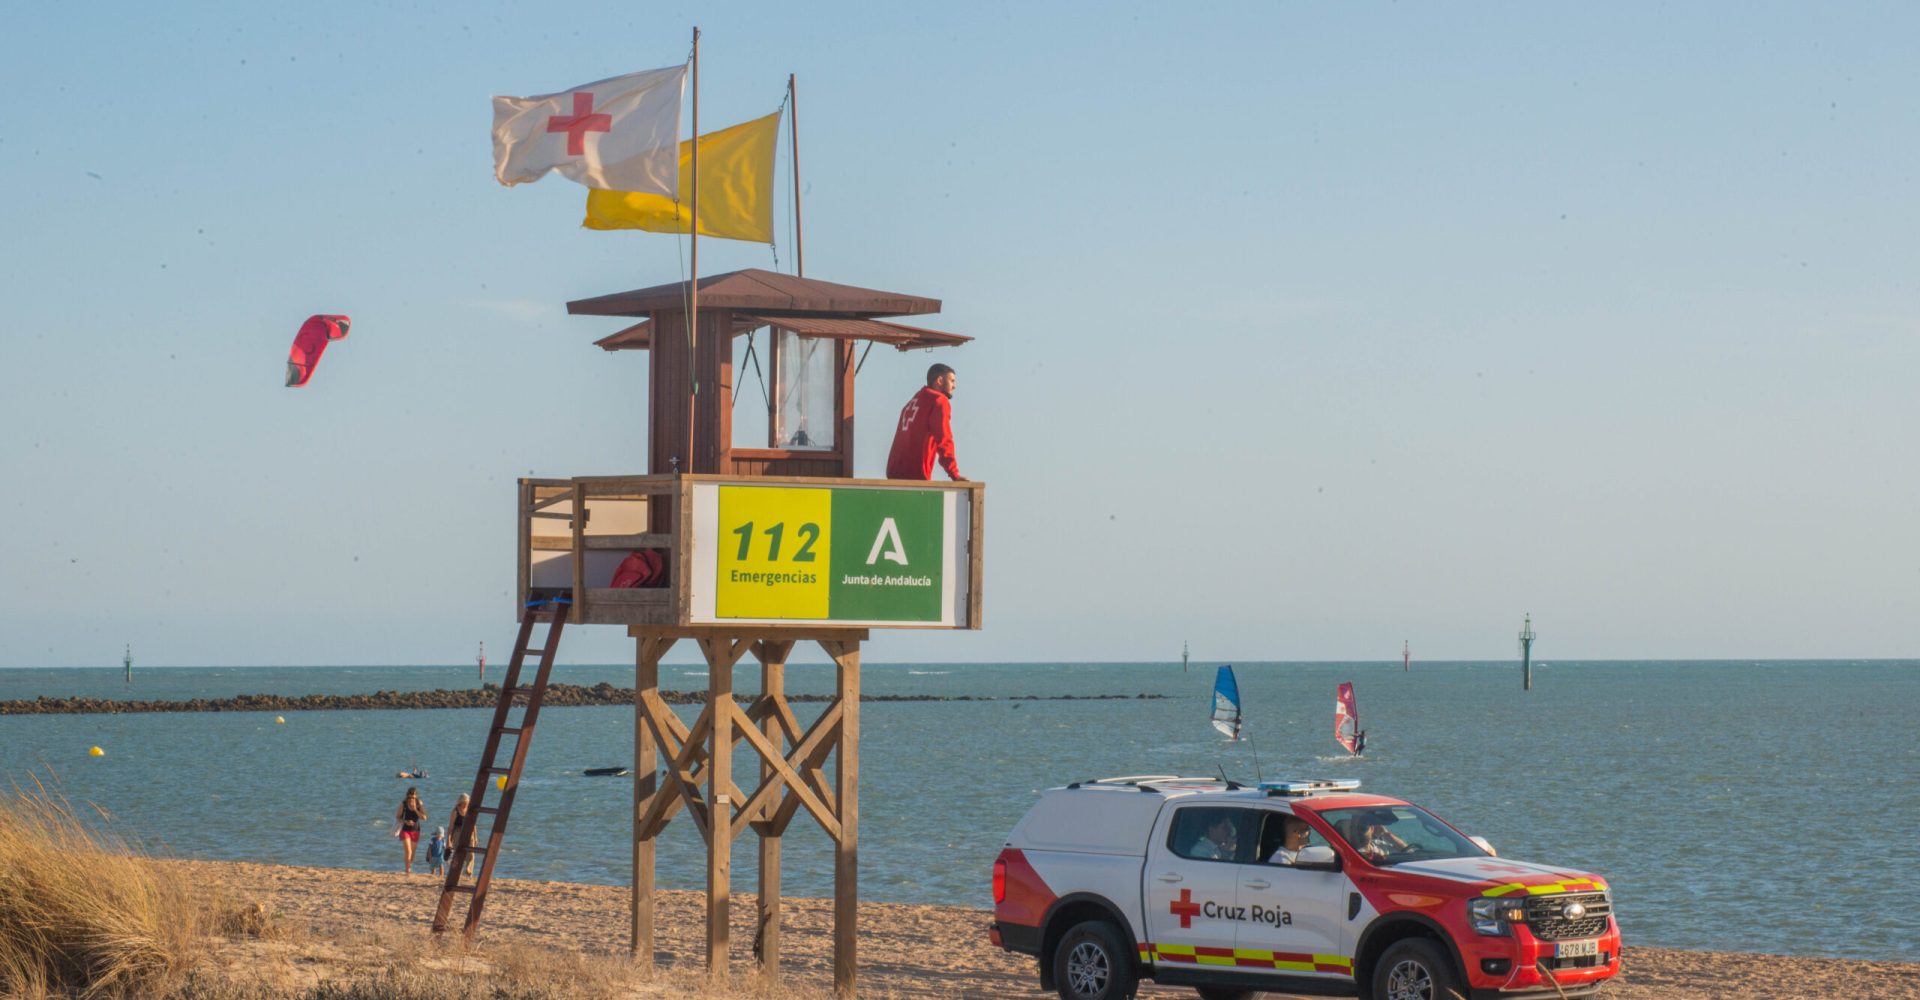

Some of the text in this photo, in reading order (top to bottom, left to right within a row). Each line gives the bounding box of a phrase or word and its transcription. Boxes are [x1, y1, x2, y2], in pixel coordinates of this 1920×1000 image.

[733, 521, 820, 562] 112
[731, 570, 817, 587] Emergencias
[842, 574, 931, 586] Junta de Andalucía
[1203, 901, 1292, 928] Cruz Roja
